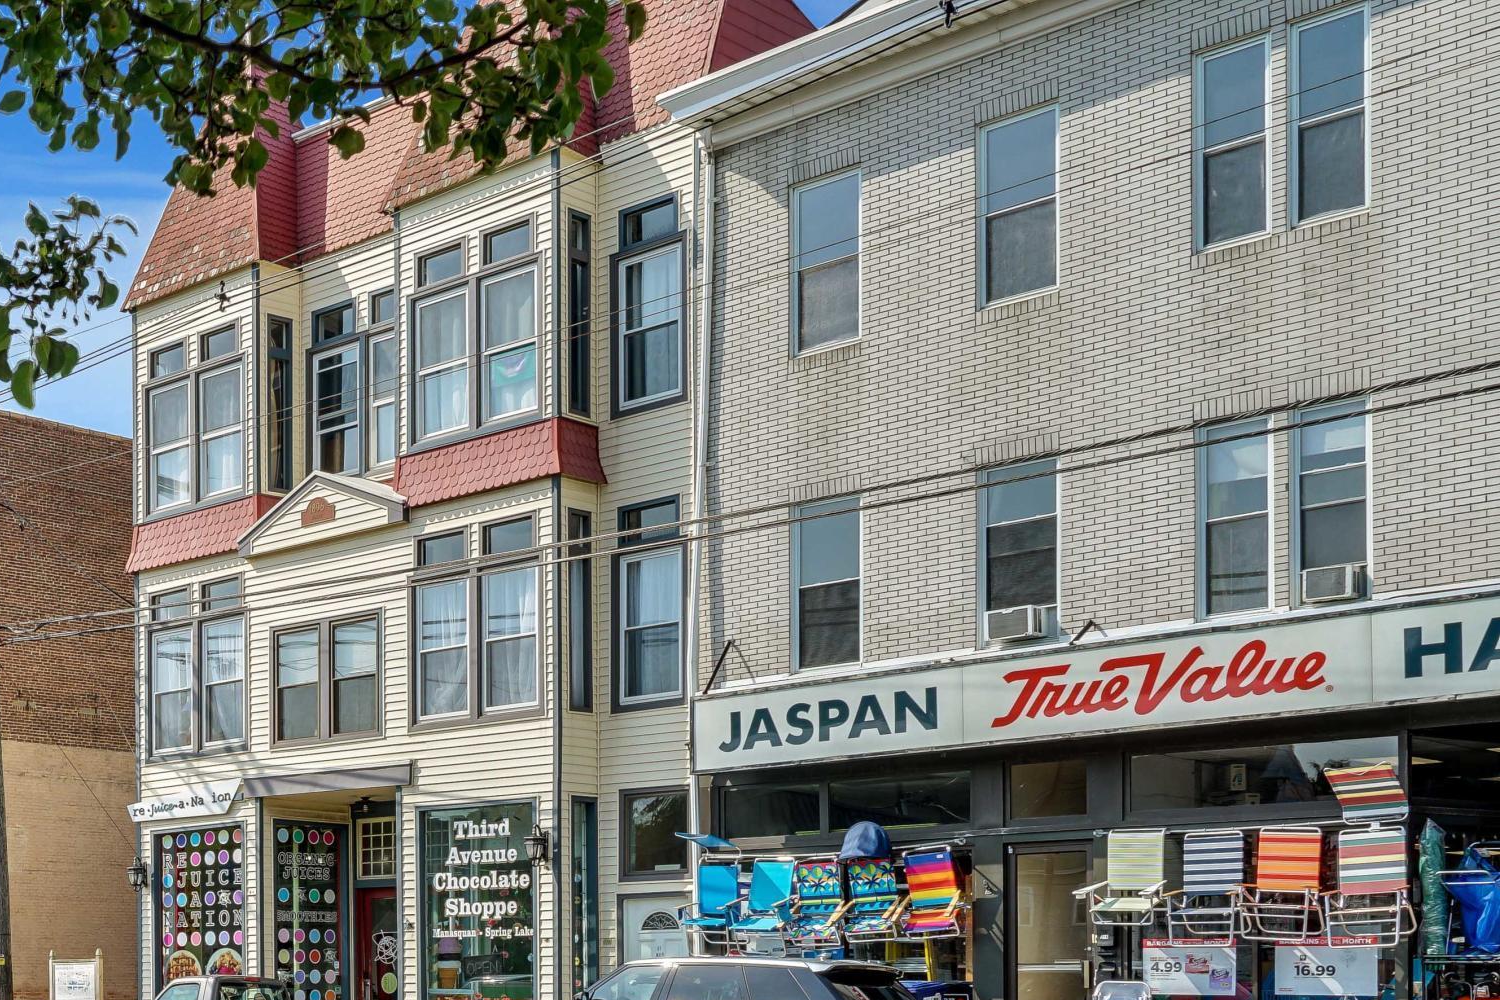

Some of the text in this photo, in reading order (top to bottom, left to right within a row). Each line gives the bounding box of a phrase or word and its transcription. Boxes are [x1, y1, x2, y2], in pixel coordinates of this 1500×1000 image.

[718, 686, 938, 753] JASPAN
[991, 664, 1129, 728] True
[1099, 639, 1327, 716] Value
[454, 817, 511, 839] Third
[163, 852, 187, 870] RE
[277, 851, 335, 867] ORGANIC
[445, 847, 518, 867] Avenue
[177, 868, 243, 889] JUICE
[282, 866, 331, 880] JUICES
[433, 869, 530, 891] Chocolate
[276, 910, 338, 923] SMOOTHIES
[445, 897, 518, 920] Shoppe
[163, 909, 243, 929] NATION
[433, 926, 534, 939] Manasquan Spring Lake
[1150, 961, 1182, 973] 4.99
[1294, 965, 1336, 976] 16.99
